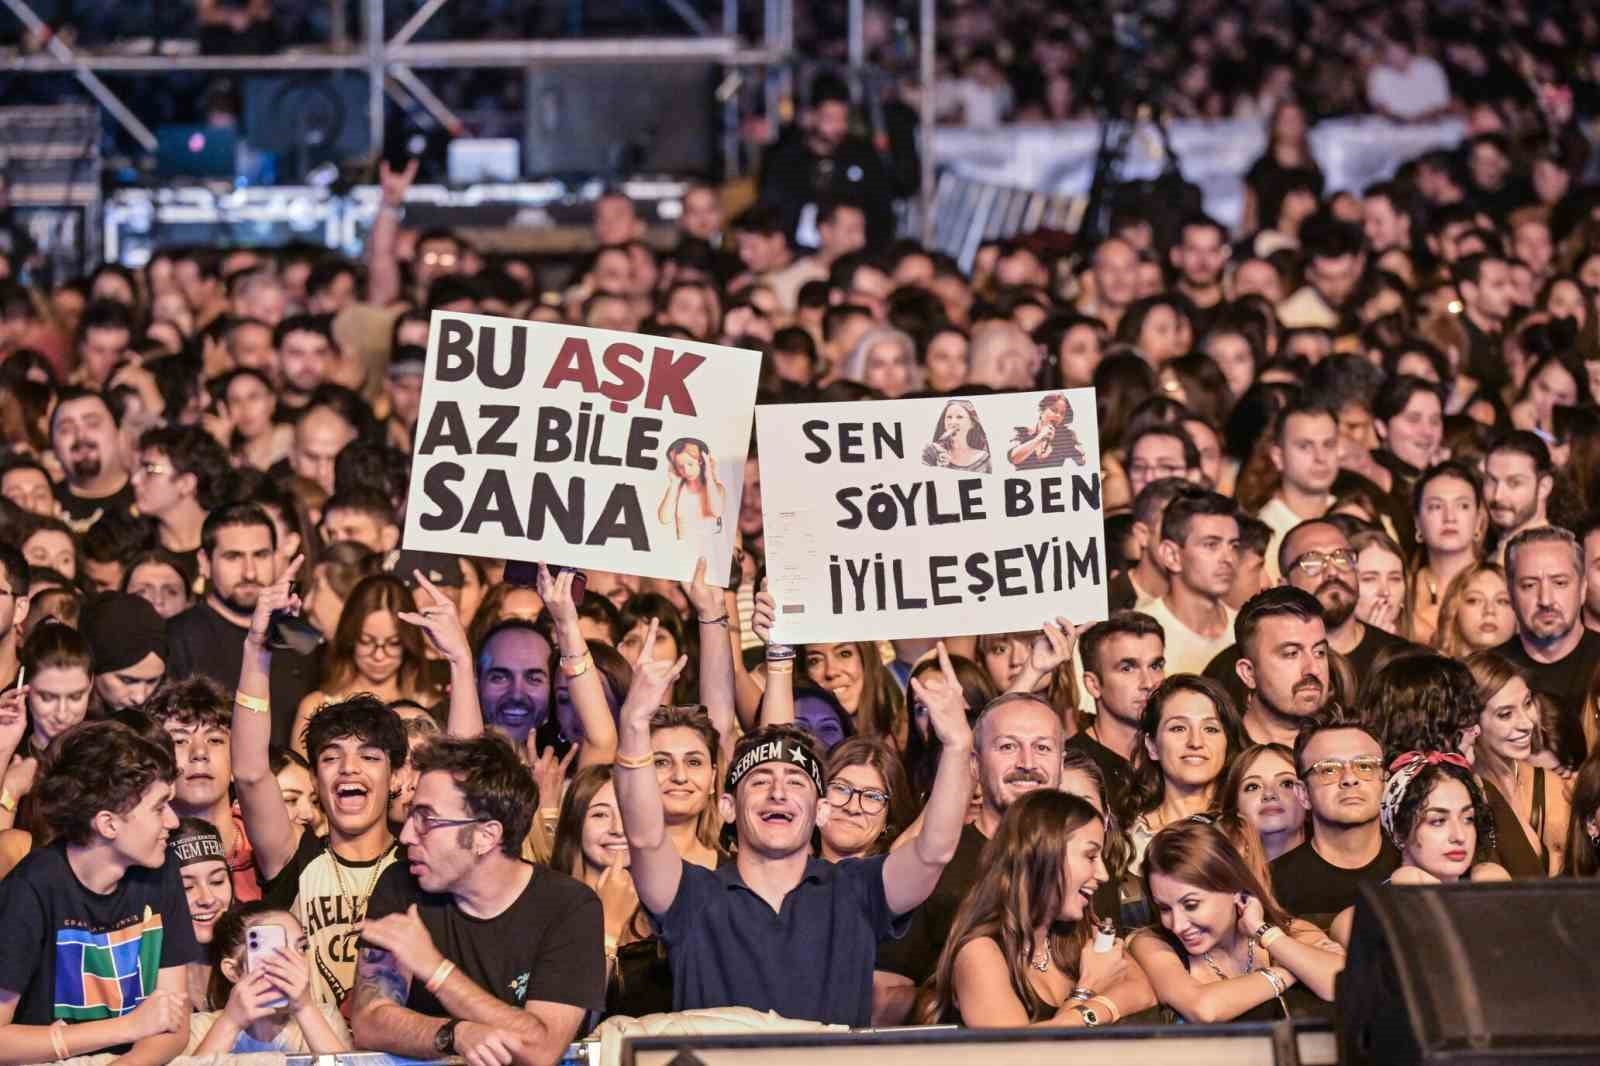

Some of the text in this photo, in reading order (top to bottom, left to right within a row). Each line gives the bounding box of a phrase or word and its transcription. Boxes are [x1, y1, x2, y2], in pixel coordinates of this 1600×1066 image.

[435, 318, 707, 417] BU AŞK
[418, 400, 663, 471] AZ BİLE
[802, 419, 905, 464] SEN
[419, 461, 652, 552] SANA
[835, 472, 1101, 531] SÖYLE BEN
[828, 536, 1101, 615] İYİLEŞEYİM
